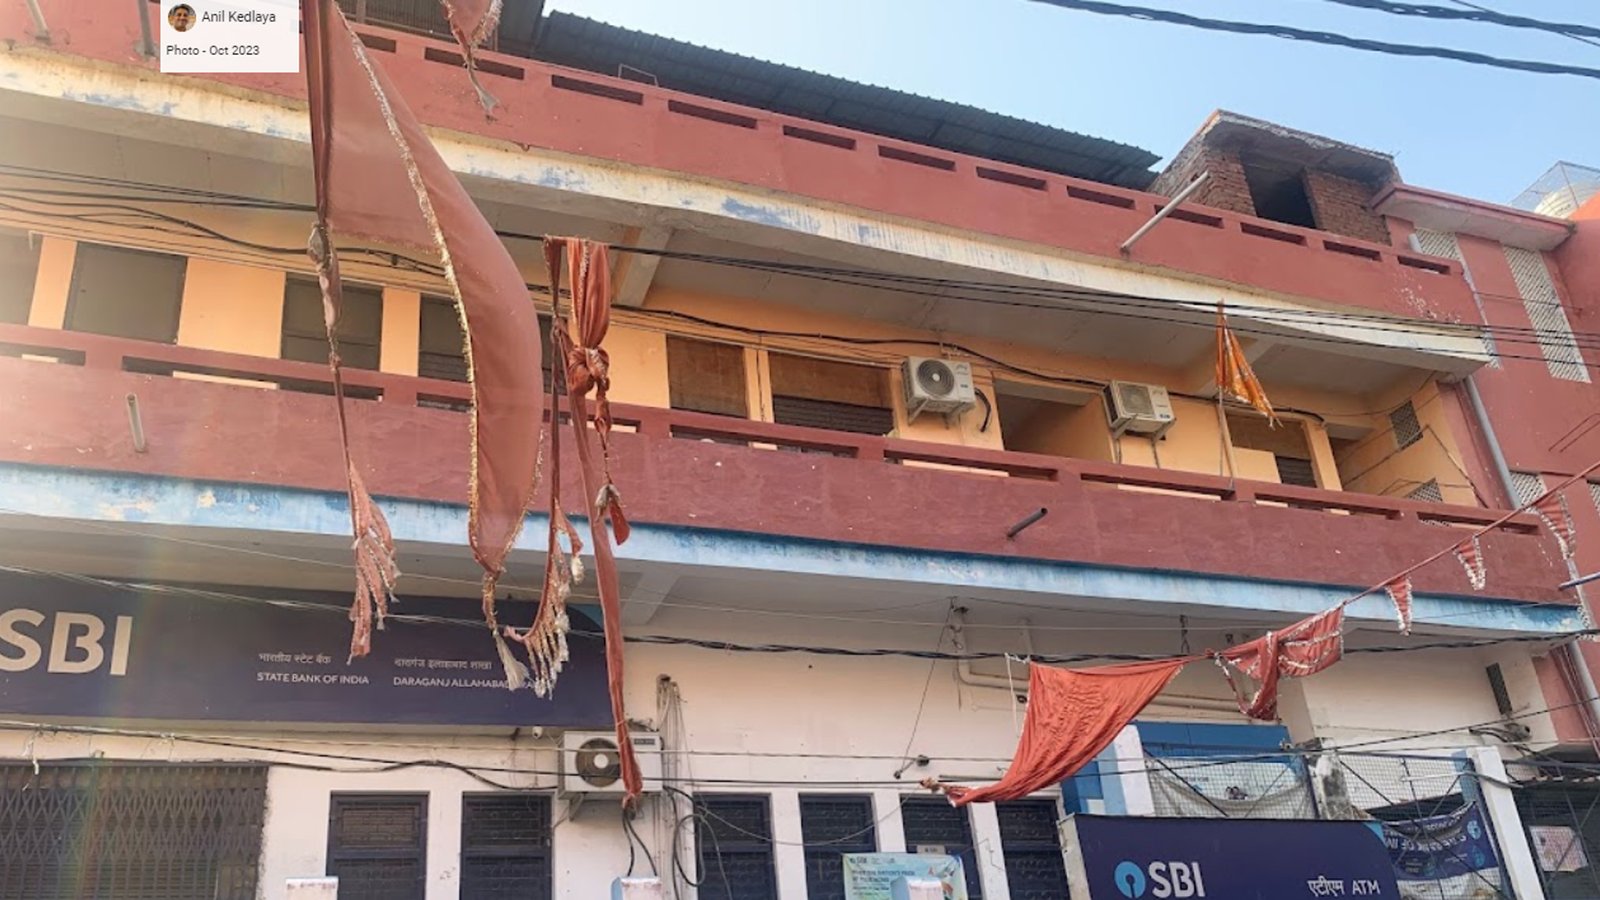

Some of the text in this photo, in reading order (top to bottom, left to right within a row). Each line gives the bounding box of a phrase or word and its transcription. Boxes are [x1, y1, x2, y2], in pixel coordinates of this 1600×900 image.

[0, 608, 133, 676] SBI
[258, 652, 332, 664] भारतीय स्टेट बैंक
[257, 672, 369, 684] STATE BANK OF INDIA
[393, 677, 451, 687] DARAGANJ
[1148, 861, 1206, 898] SBI
[1307, 875, 1380, 897] एटीएम ATM
